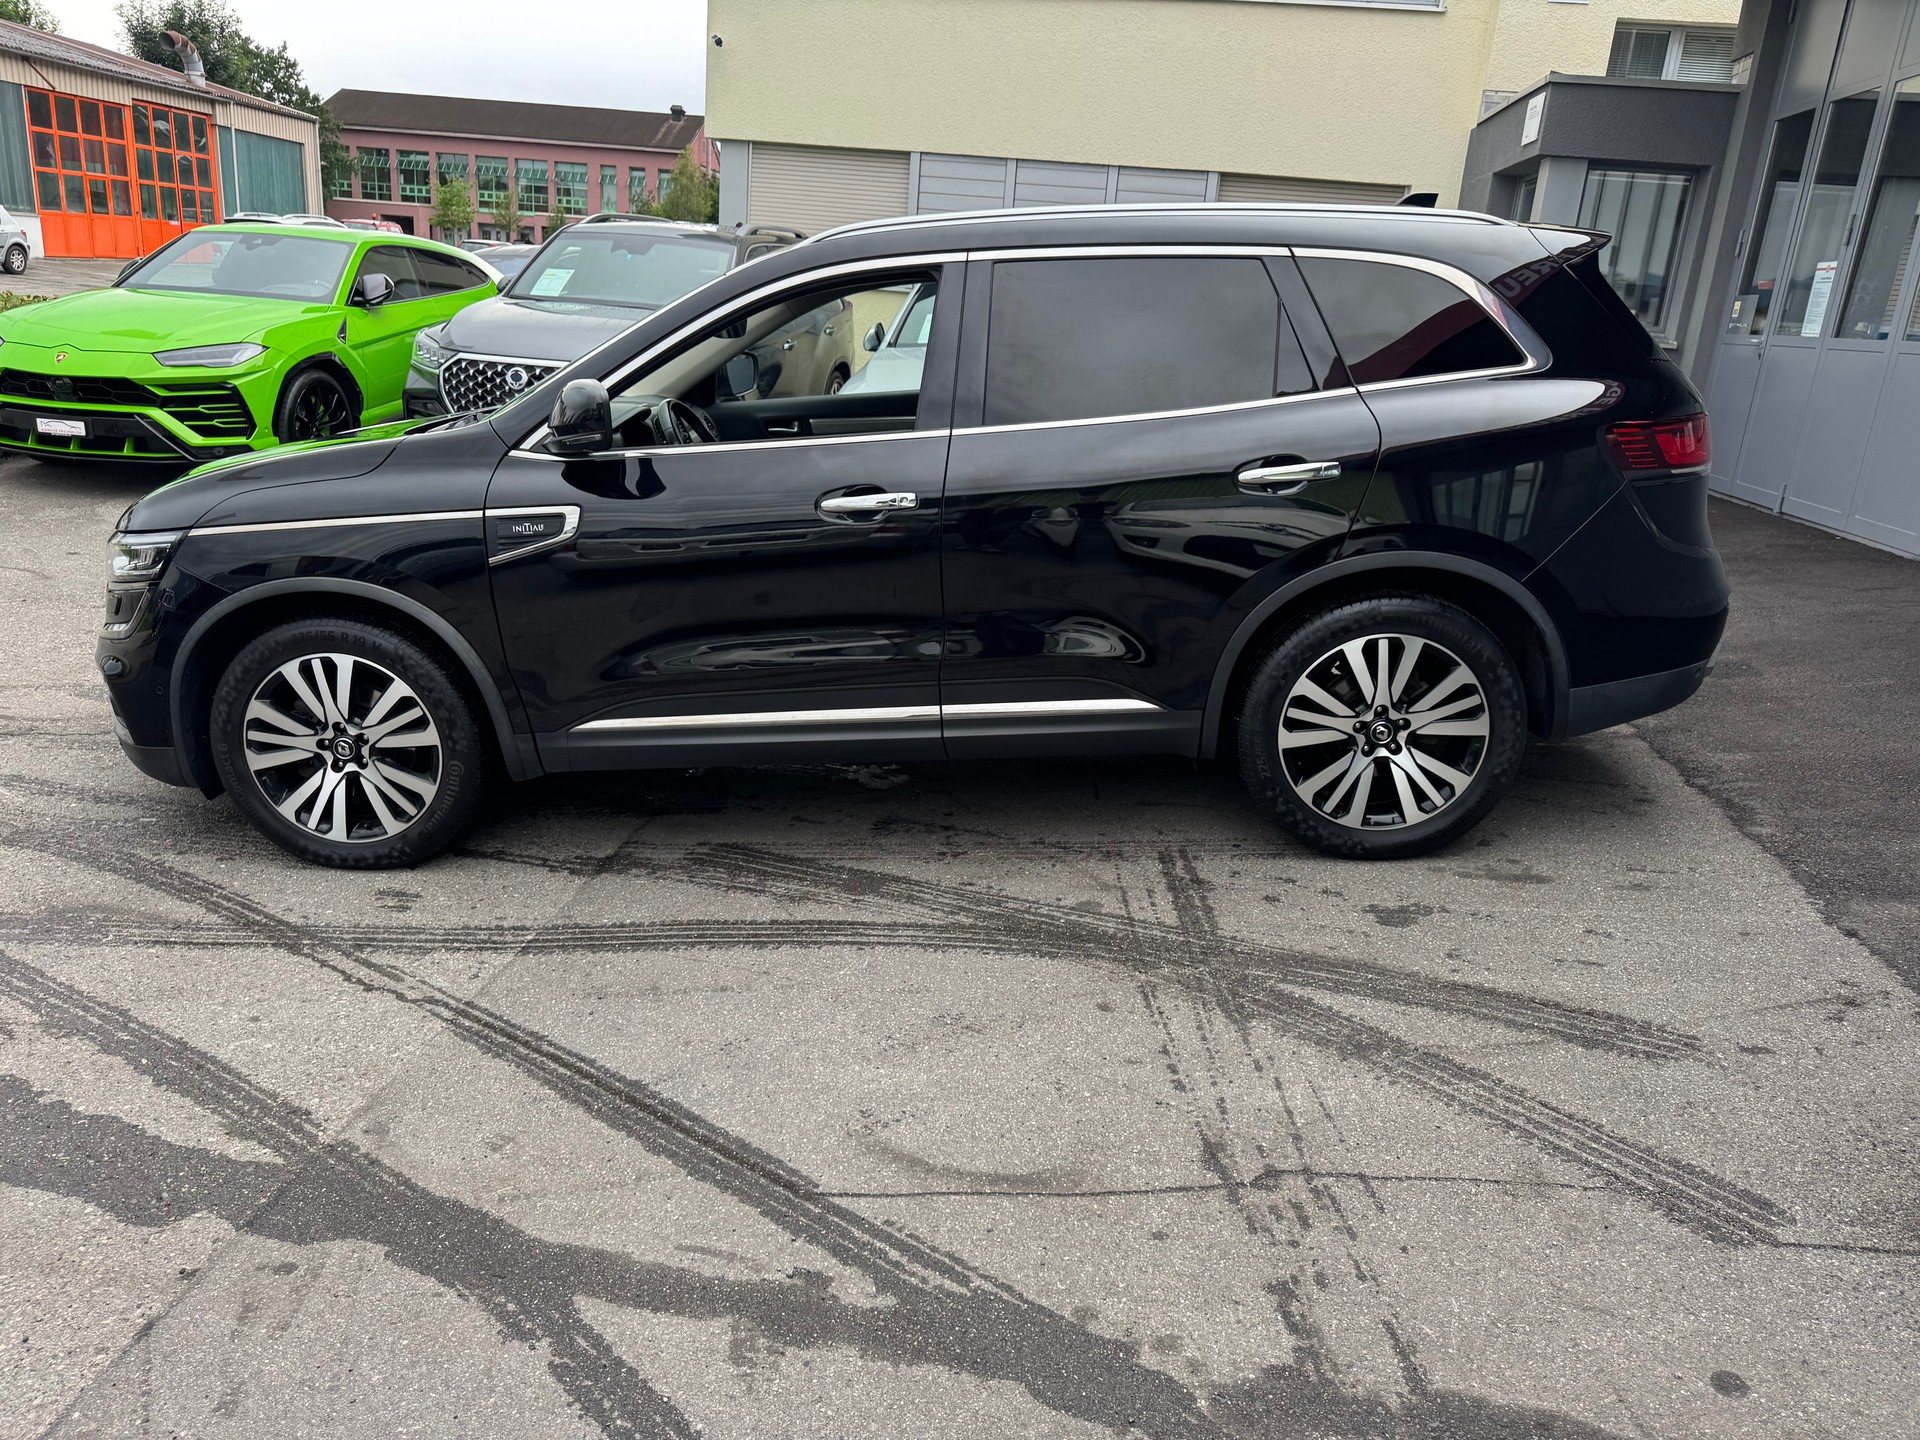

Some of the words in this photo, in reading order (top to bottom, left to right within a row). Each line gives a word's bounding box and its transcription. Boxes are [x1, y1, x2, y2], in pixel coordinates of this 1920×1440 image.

[290, 629, 336, 644] 225/55
[340, 632, 349, 643] R
[352, 635, 366, 647] 19
